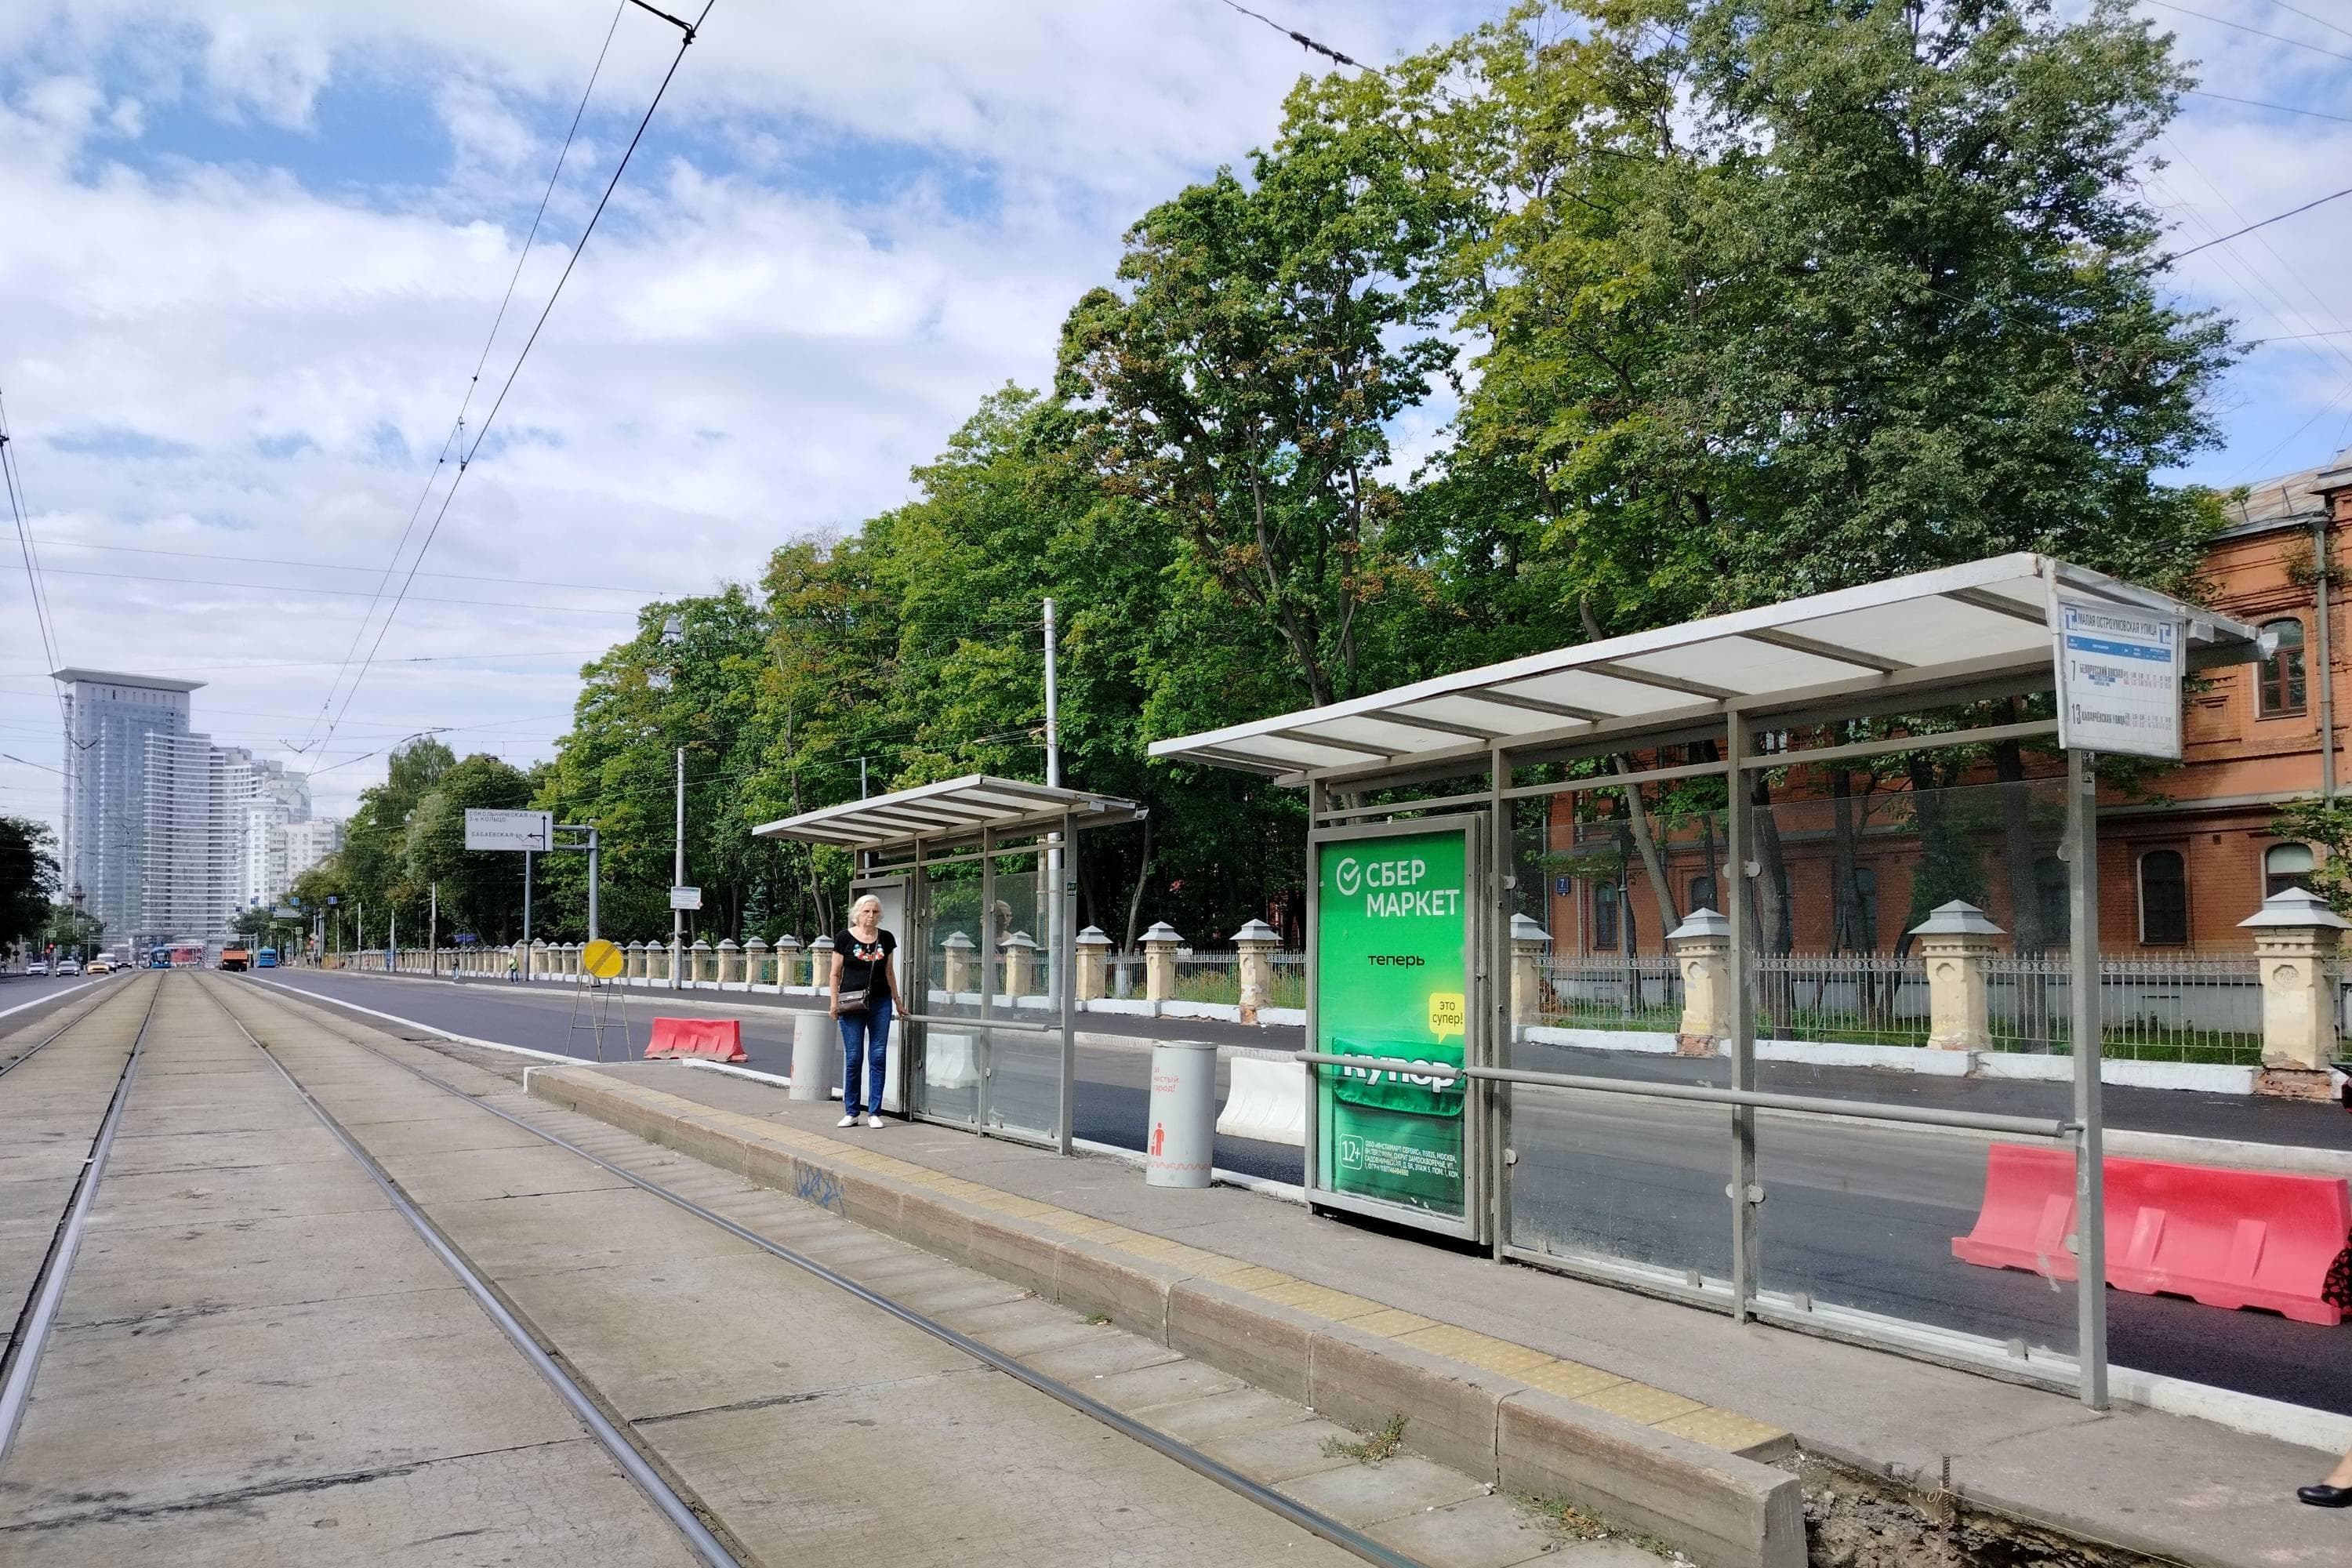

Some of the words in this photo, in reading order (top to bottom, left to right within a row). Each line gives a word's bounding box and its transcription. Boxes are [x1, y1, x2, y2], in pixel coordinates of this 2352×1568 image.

[2078, 613, 2096, 627] МАЛАЯ
[2096, 616, 2140, 633] ОСТРОУМОВСКАЯ
[2140, 622, 2158, 637] УЛИЦА
[2071, 661, 2076, 681] 7
[2071, 703, 2082, 725] 13
[1366, 859, 1426, 887] СБЕР
[1560, 878, 1565, 887] 7
[1367, 889, 1461, 917] МАРКЕТ
[1367, 954, 1425, 969] теперь
[1439, 1000, 1456, 1011] это
[1432, 1011, 1463, 1027] супер!
[1341, 1140, 1361, 1163] 12+
